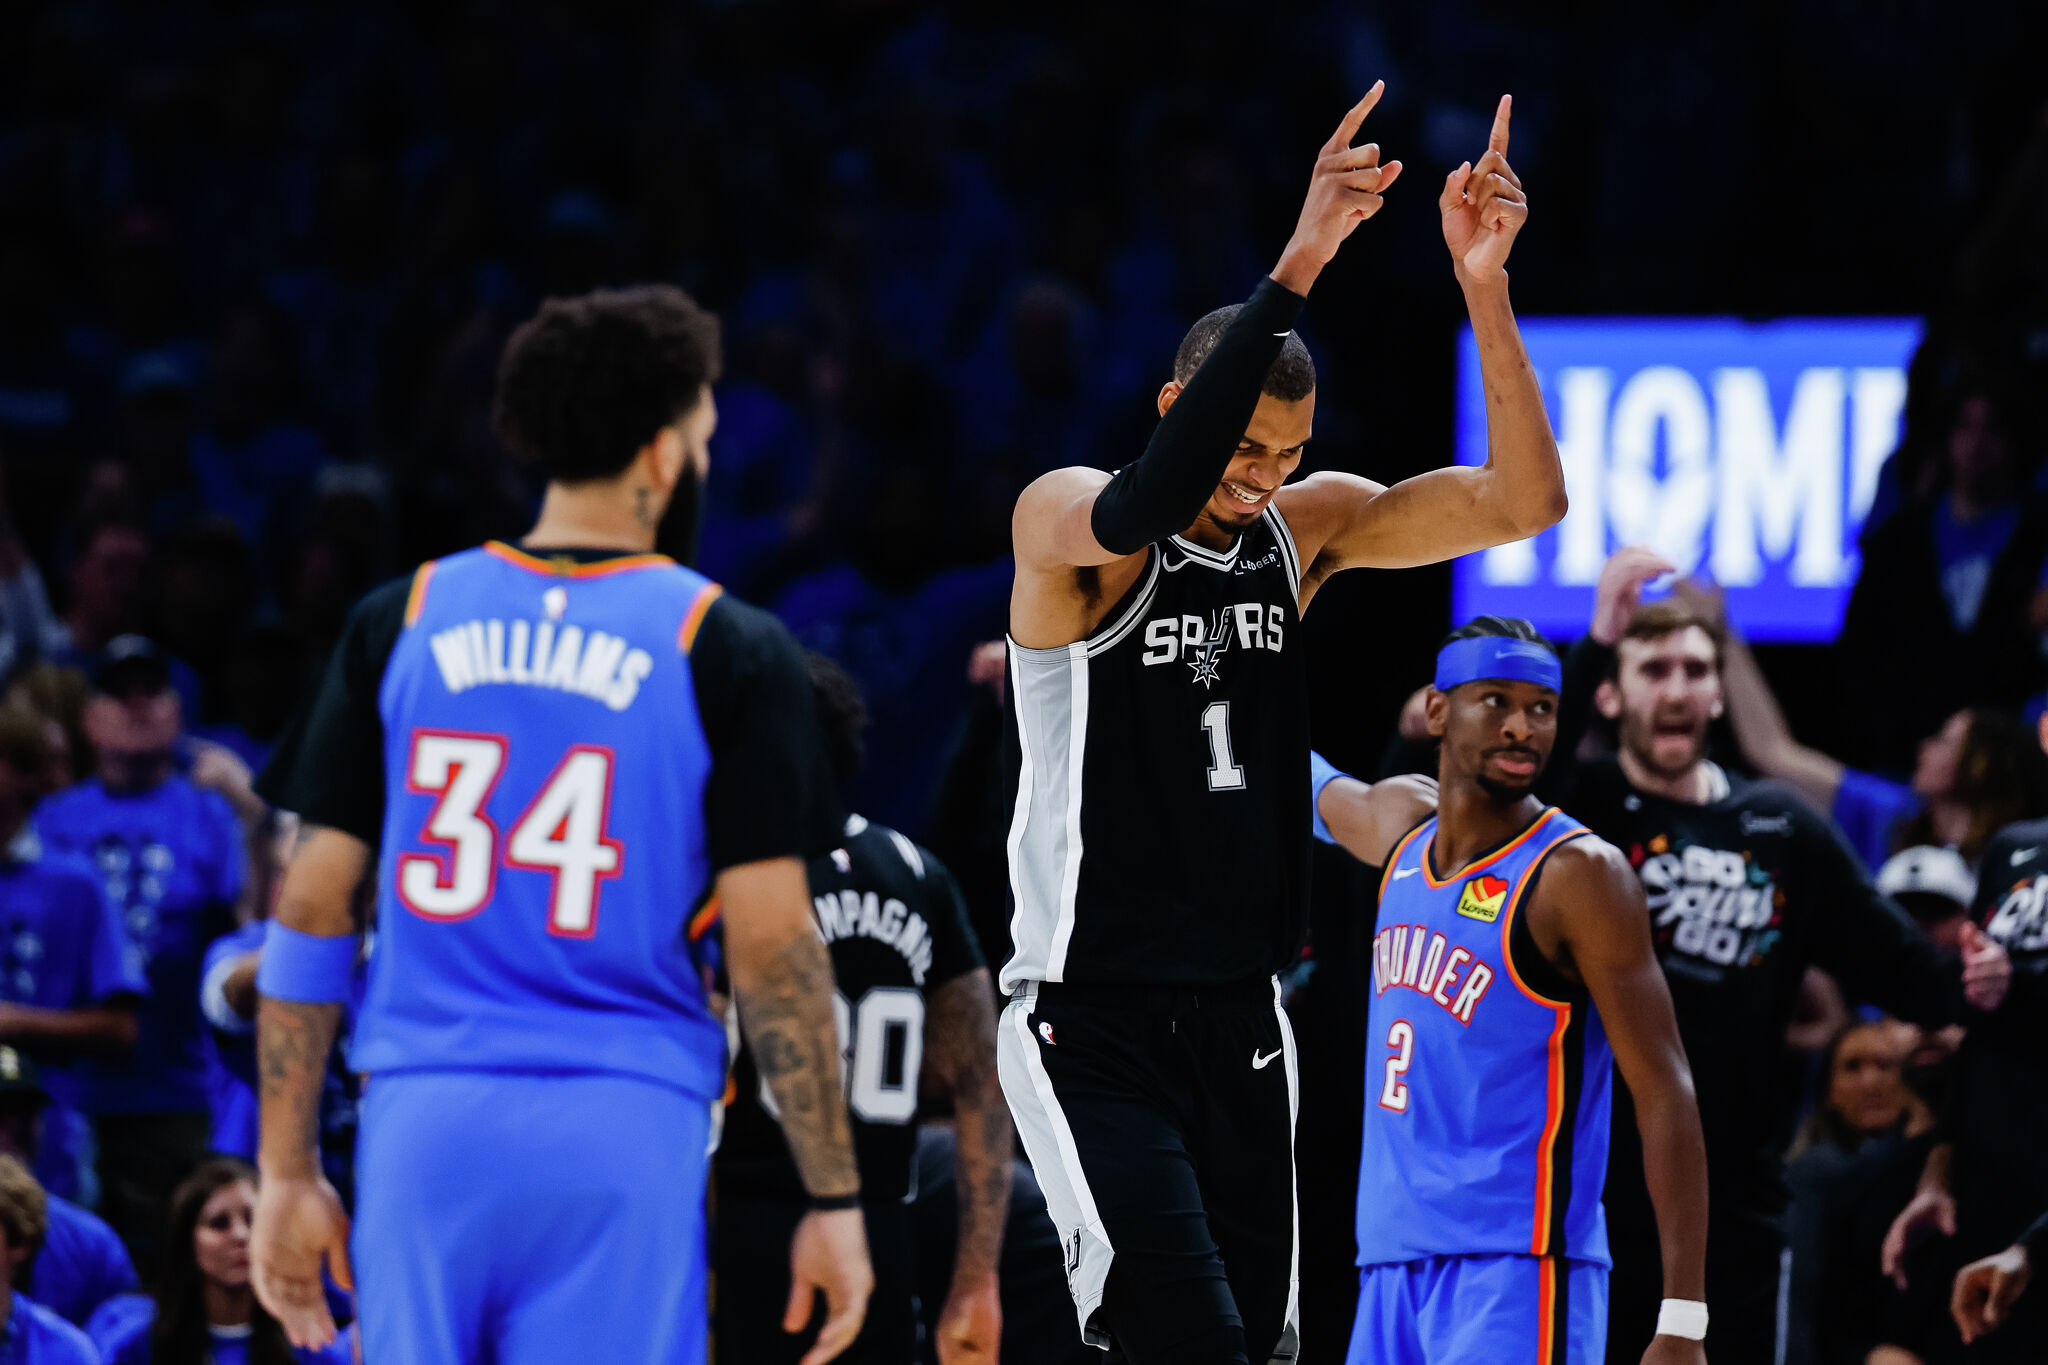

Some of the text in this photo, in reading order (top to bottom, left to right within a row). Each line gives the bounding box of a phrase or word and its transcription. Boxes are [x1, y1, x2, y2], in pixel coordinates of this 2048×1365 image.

[1239, 552, 1277, 572] LEDGER
[430, 618, 654, 711] WILLIAMS
[1142, 602, 1284, 690] SPURS
[1201, 701, 1246, 791] 1
[395, 728, 626, 940] 34
[1378, 1018, 1414, 1114] 2
